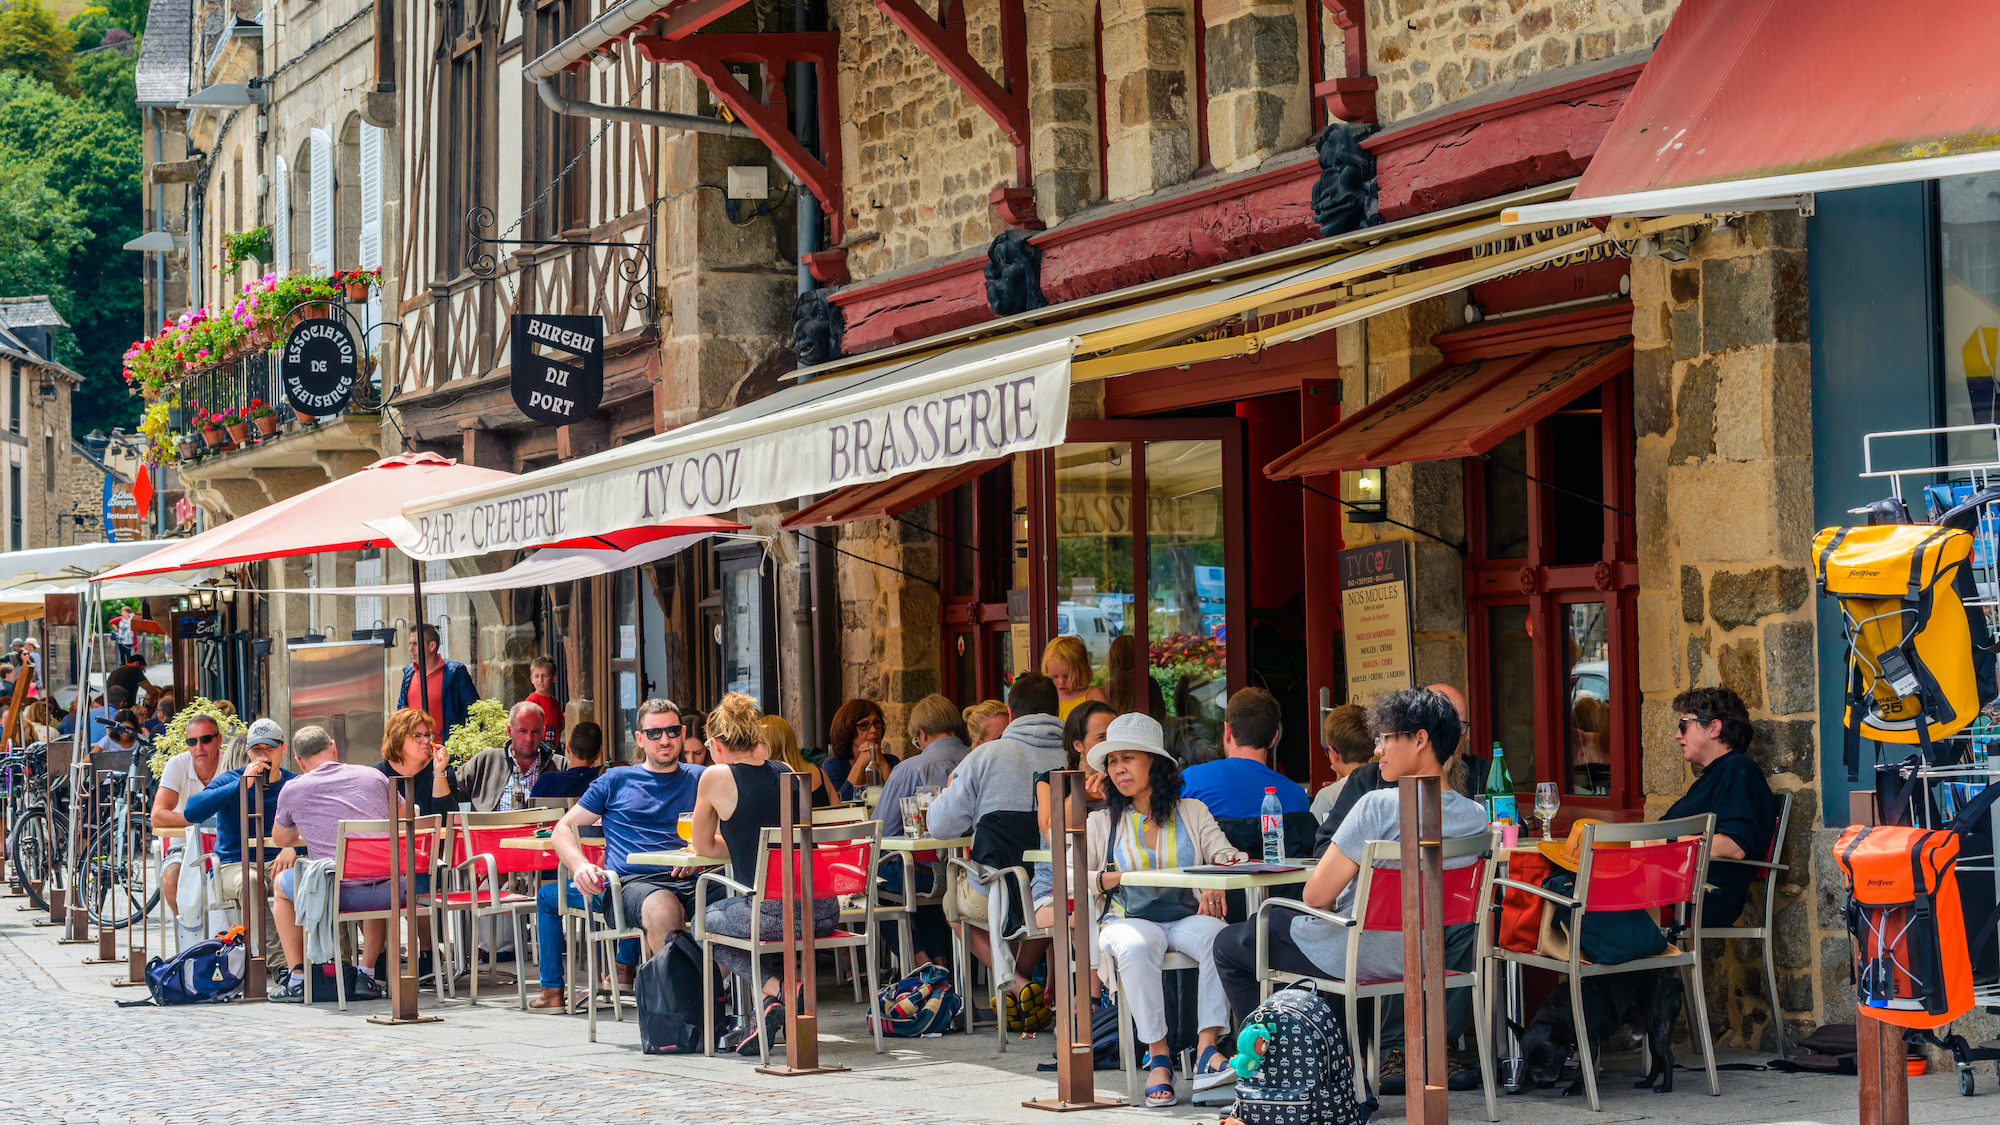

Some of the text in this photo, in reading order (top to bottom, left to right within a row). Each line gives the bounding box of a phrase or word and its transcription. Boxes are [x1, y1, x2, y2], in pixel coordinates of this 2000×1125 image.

[288, 324, 353, 364] ASSOCIATION
[527, 319, 595, 354] BUREAU
[310, 360, 328, 373] DE
[545, 366, 570, 388] DU
[288, 375, 353, 408] PLAISANCE
[528, 390, 574, 416] PORT
[828, 375, 1038, 484] BRASSERIE
[636, 447, 742, 519] TY COZ
[404, 512, 455, 557] BAR
[471, 487, 569, 550] CREPERIE
[1345, 555, 1362, 577] TY
[1366, 549, 1393, 573] COZ
[1348, 585, 1398, 606] NOS MOULES
[1356, 632, 1372, 641] MOULES
[1360, 645, 1376, 655] MOULES
[1351, 674, 1367, 683] MOULES
[1386, 670, 1406, 679] LARDONS
[1362, 660, 1378, 669] MOULES
